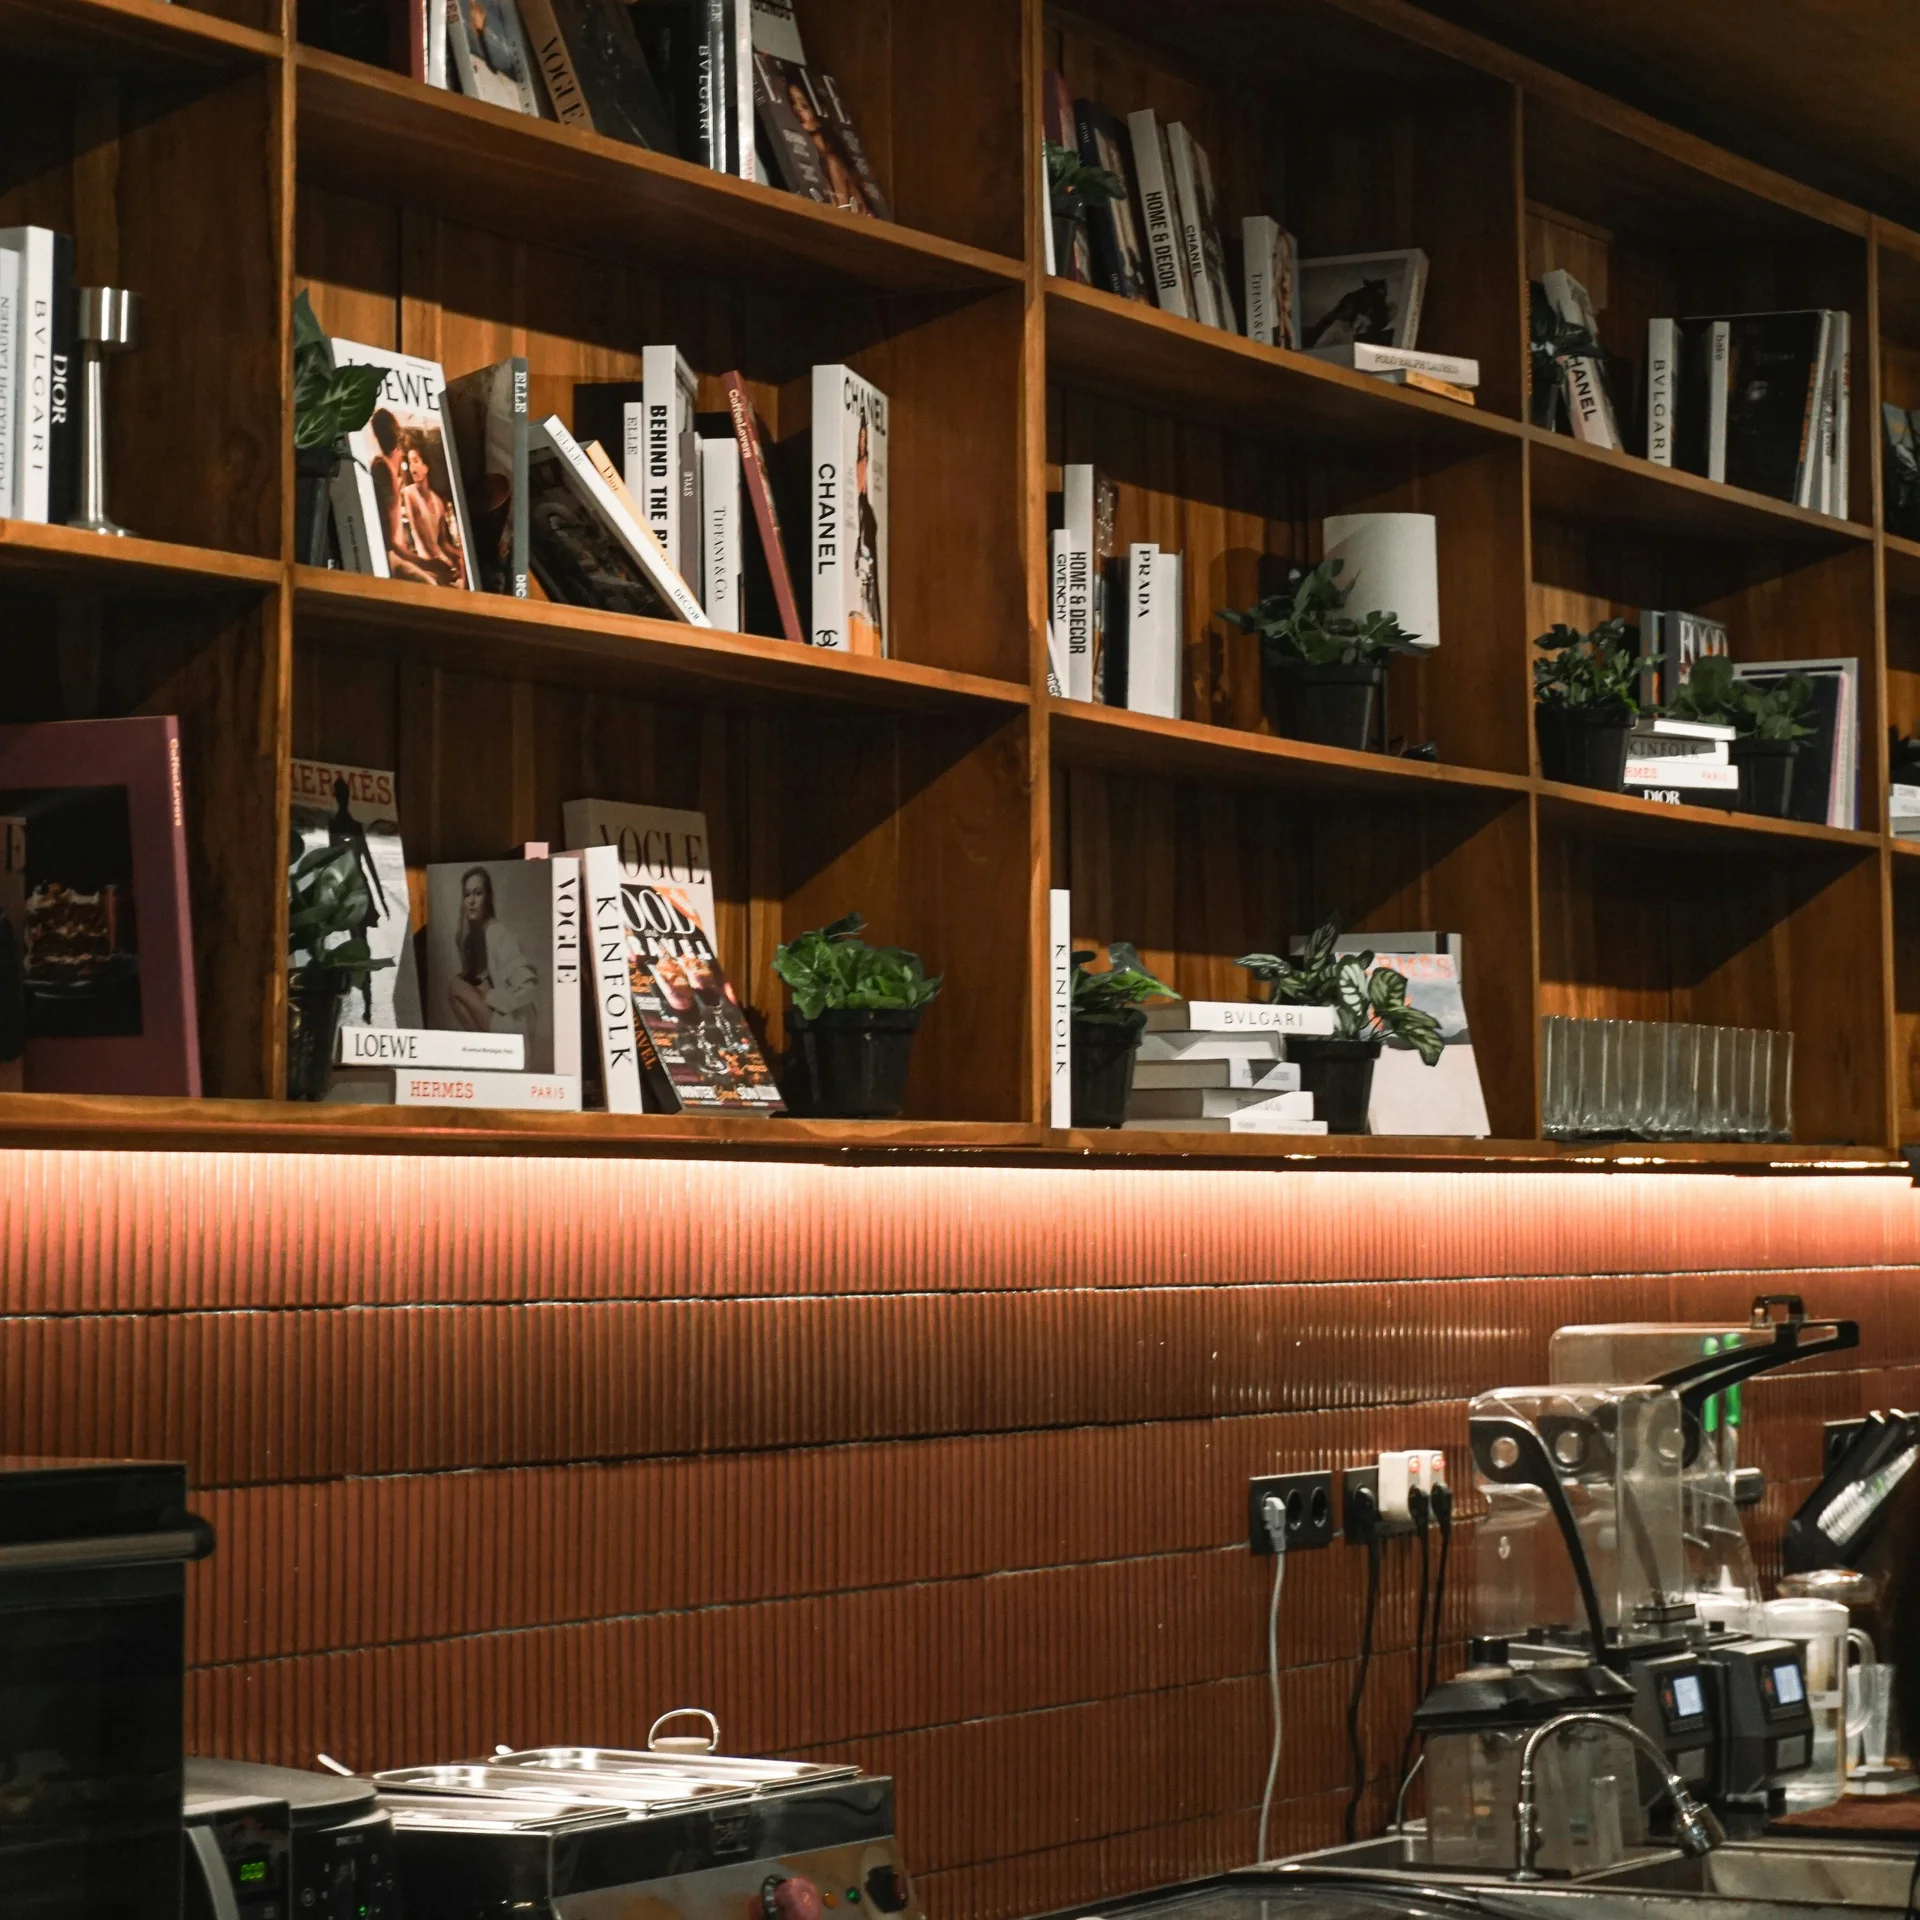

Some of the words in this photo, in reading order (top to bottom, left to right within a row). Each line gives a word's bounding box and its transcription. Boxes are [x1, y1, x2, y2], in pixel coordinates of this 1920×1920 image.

[541, 37, 585, 127] VOGUE
[698, 45, 708, 140] BVLGARI
[1145, 191, 1167, 229] HOME
[1153, 233, 1164, 243] &
[1186, 225, 1202, 279] CHANEL
[1154, 245, 1177, 290] DECOR
[31, 300, 46, 471] BVLGARI
[51, 353, 69, 425] DIOR
[348, 358, 441, 411] EWE
[514, 371, 528, 413] ELLE
[843, 376, 886, 436] CHANEL
[1567, 355, 1599, 422] HANEL
[1653, 359, 1665, 461] BVLGARI
[627, 416, 638, 456] ELLE
[650, 404, 668, 477] BEHIND
[728, 388, 752, 458] CoffeeLovers
[650, 486, 668, 521] THE
[684, 471, 693, 497] STYLE
[555, 429, 584, 467] ELLE
[673, 588, 700, 621] DECOR
[817, 463, 836, 575] CHANEL
[1056, 553, 1067, 623] GIVENCHY
[1070, 551, 1087, 591] HOME
[1137, 550, 1151, 618] PRADA
[1070, 595, 1086, 607] &
[1069, 609, 1087, 655] DECOR
[1628, 741, 1700, 760] KINFOLK
[1643, 789, 1681, 806] DIOR
[557, 877, 578, 984] VOGUE
[619, 887, 696, 935] OOD
[596, 895, 633, 1069] KINFOLK
[1055, 944, 1067, 1076] KINFOLK
[1224, 1010, 1304, 1027] BVLGARI
[354, 1033, 419, 1059] LOEWE
[531, 1085, 565, 1100] PARIS
